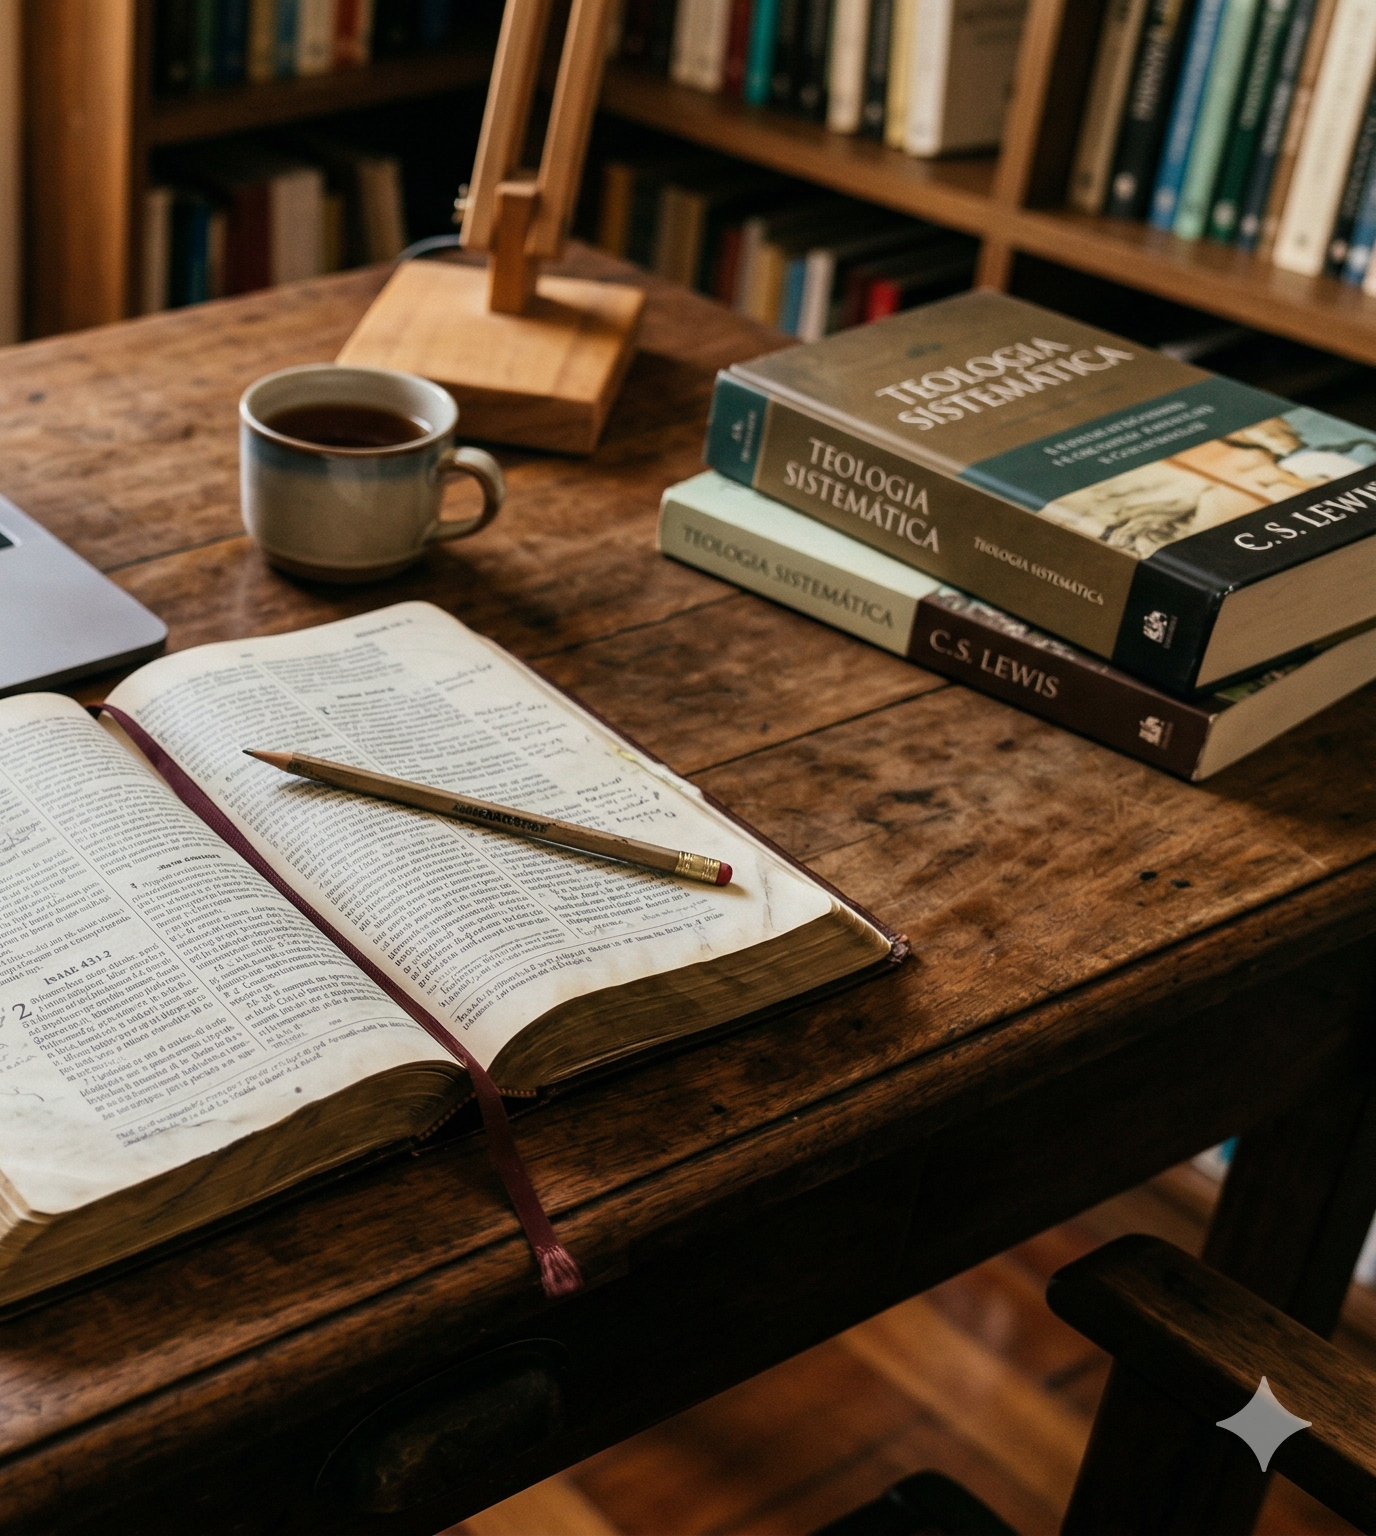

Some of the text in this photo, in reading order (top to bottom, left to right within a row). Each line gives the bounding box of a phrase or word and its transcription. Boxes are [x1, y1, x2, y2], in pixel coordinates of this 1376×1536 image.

[875, 336, 1071, 405] TEOLOGIA
[784, 460, 940, 554] SISTEMÁTICA
[808, 437, 929, 515] TEOLOGIA
[682, 523, 770, 578] TEOLOGIA
[980, 649, 1060, 699] LEWIS
[11, 1002, 33, 1021] 2
